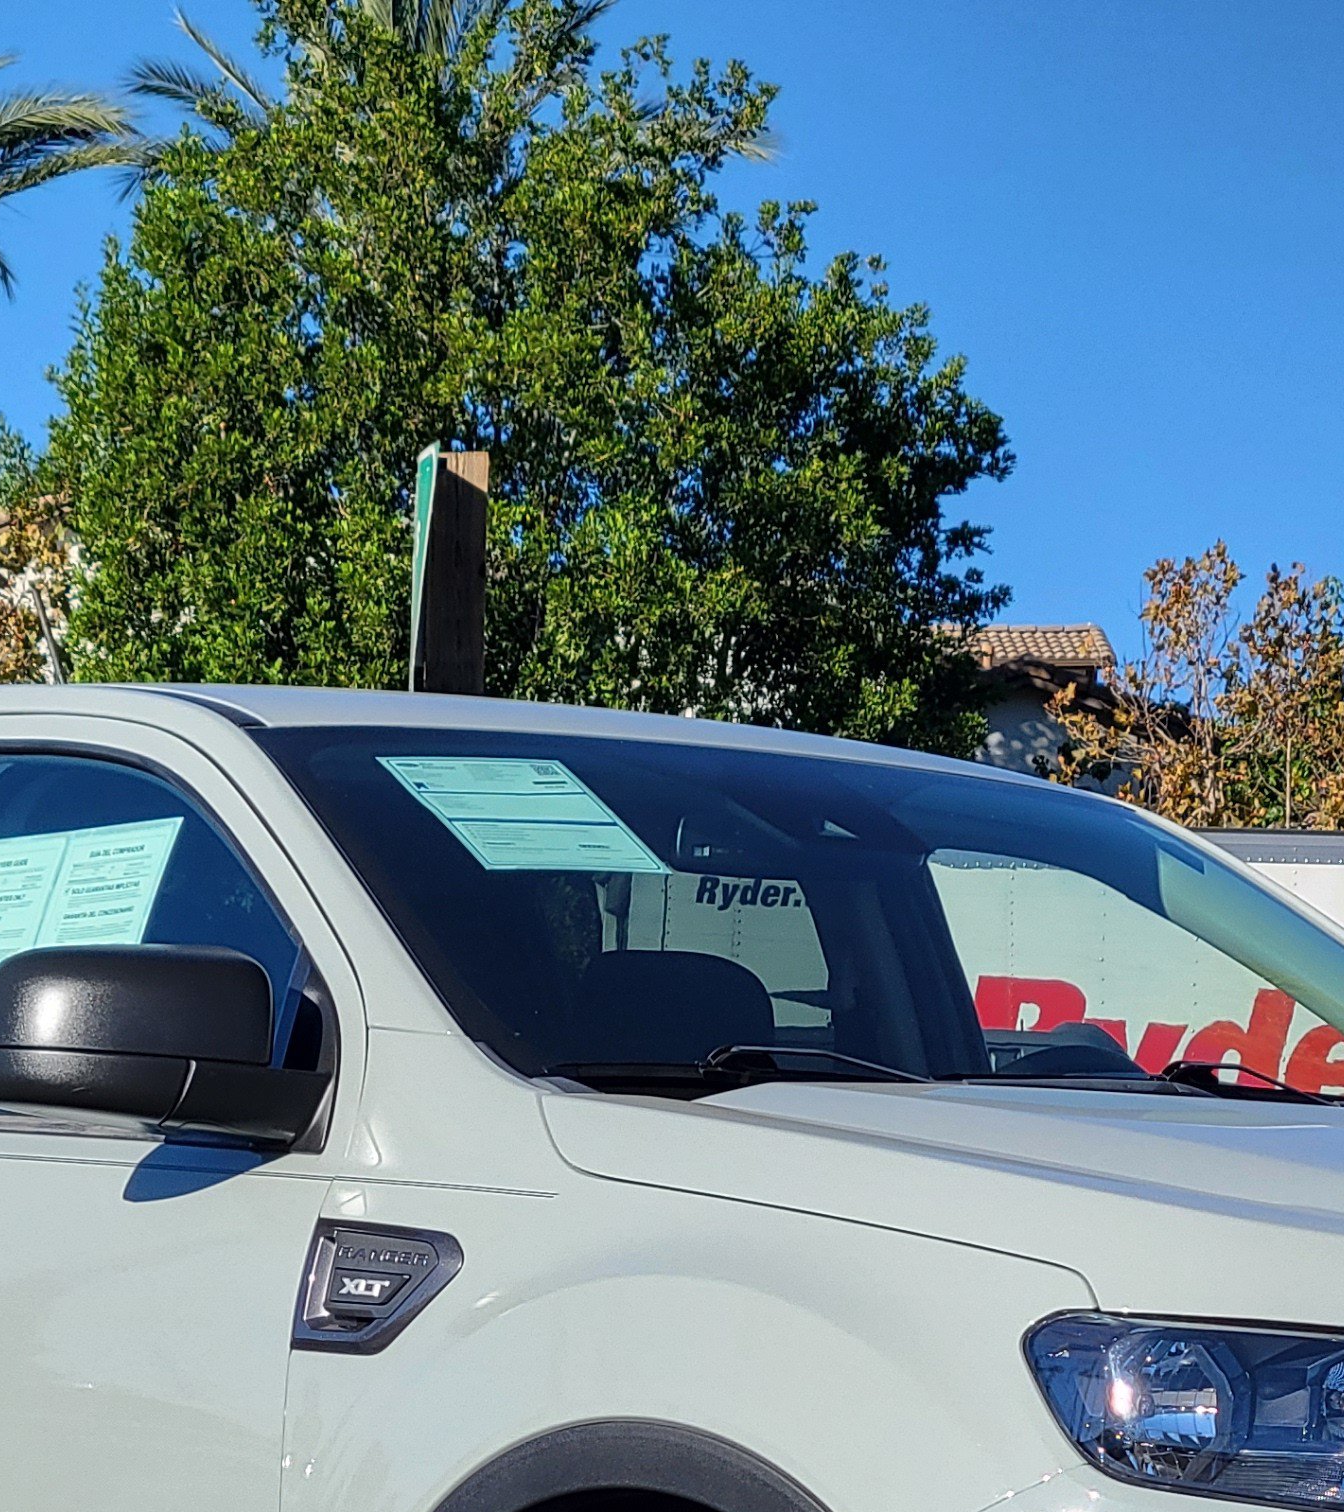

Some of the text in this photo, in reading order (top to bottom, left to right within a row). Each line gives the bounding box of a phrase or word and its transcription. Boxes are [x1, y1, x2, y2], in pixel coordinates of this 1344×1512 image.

[695, 875, 802, 911] Ryder.
[338, 1244, 430, 1266] RANGER
[338, 1276, 391, 1298] XLT
